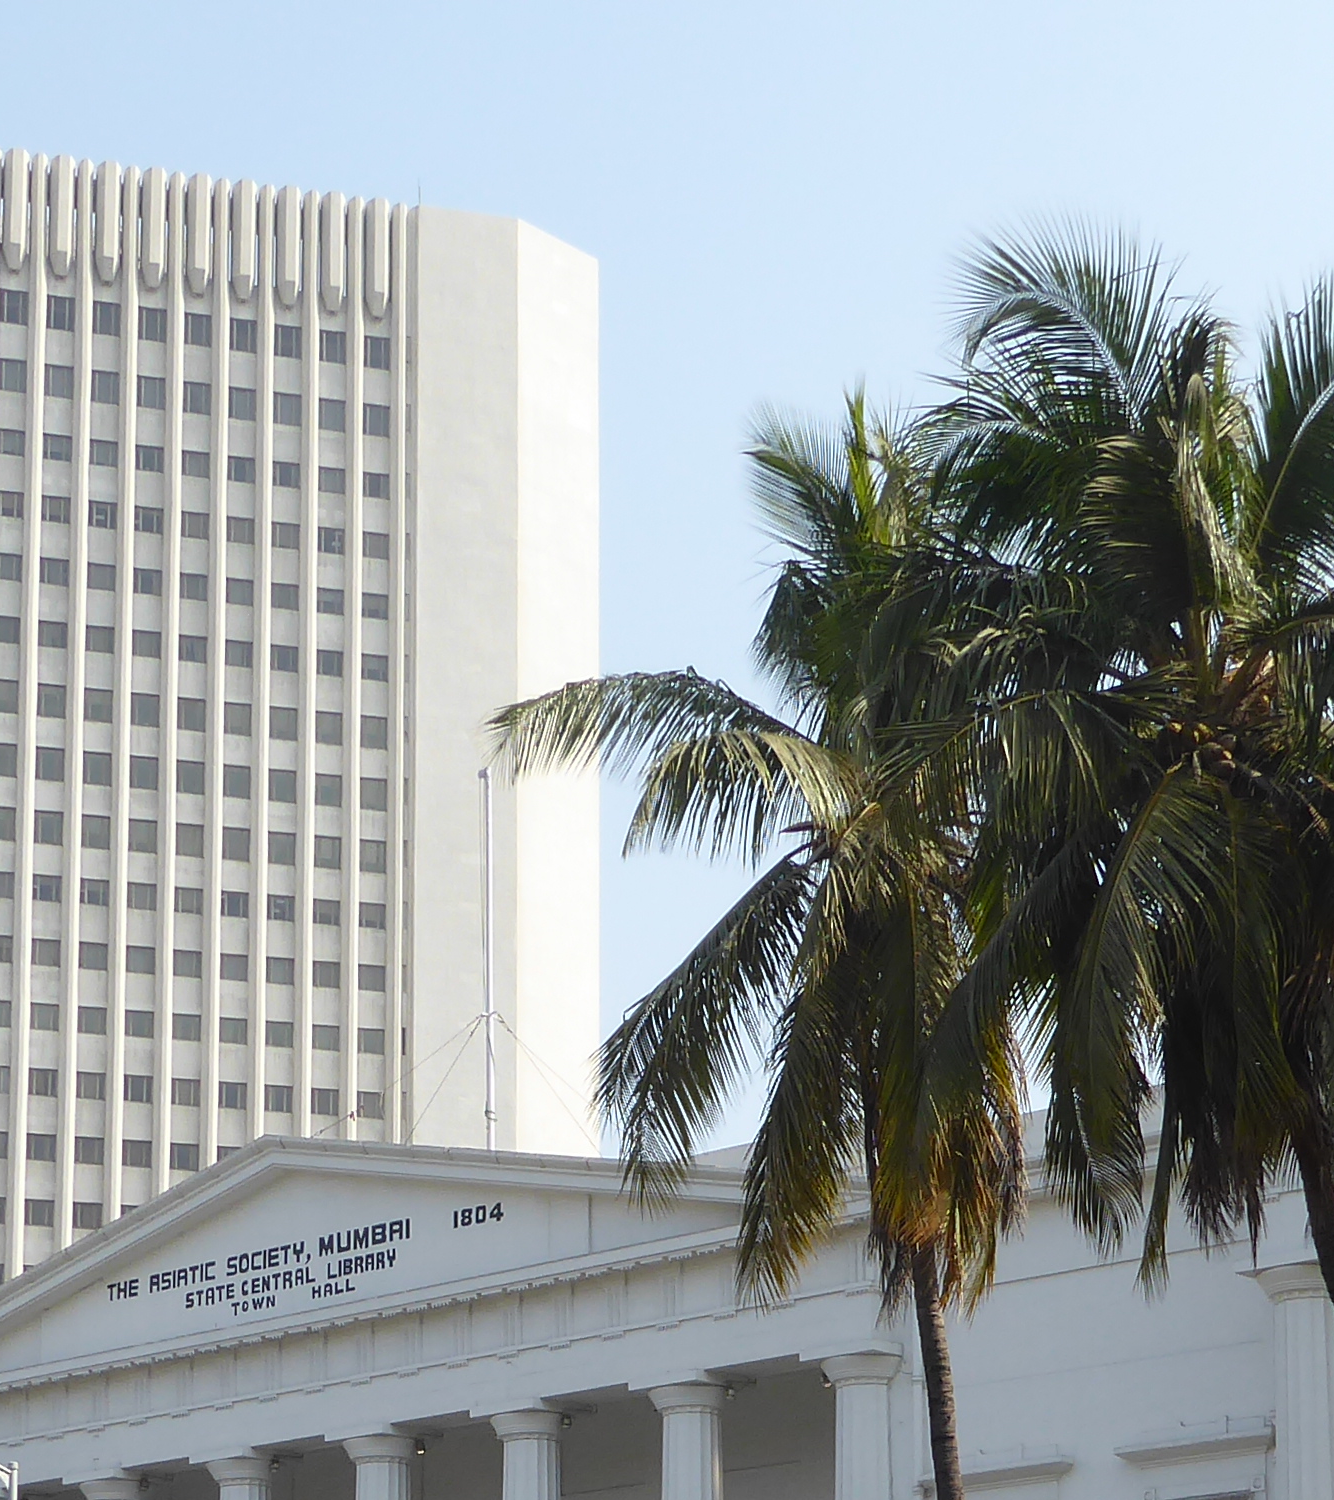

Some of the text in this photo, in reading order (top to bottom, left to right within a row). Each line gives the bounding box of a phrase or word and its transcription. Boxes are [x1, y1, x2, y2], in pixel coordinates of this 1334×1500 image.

[453, 1202, 504, 1229] 1804
[107, 1218, 410, 1301] THE ASIATIC SOCIETY, MUMBAI
[185, 1249, 396, 1309] STATE CENTRAL LIBRARY
[231, 1279, 355, 1316] TOWN HALL
